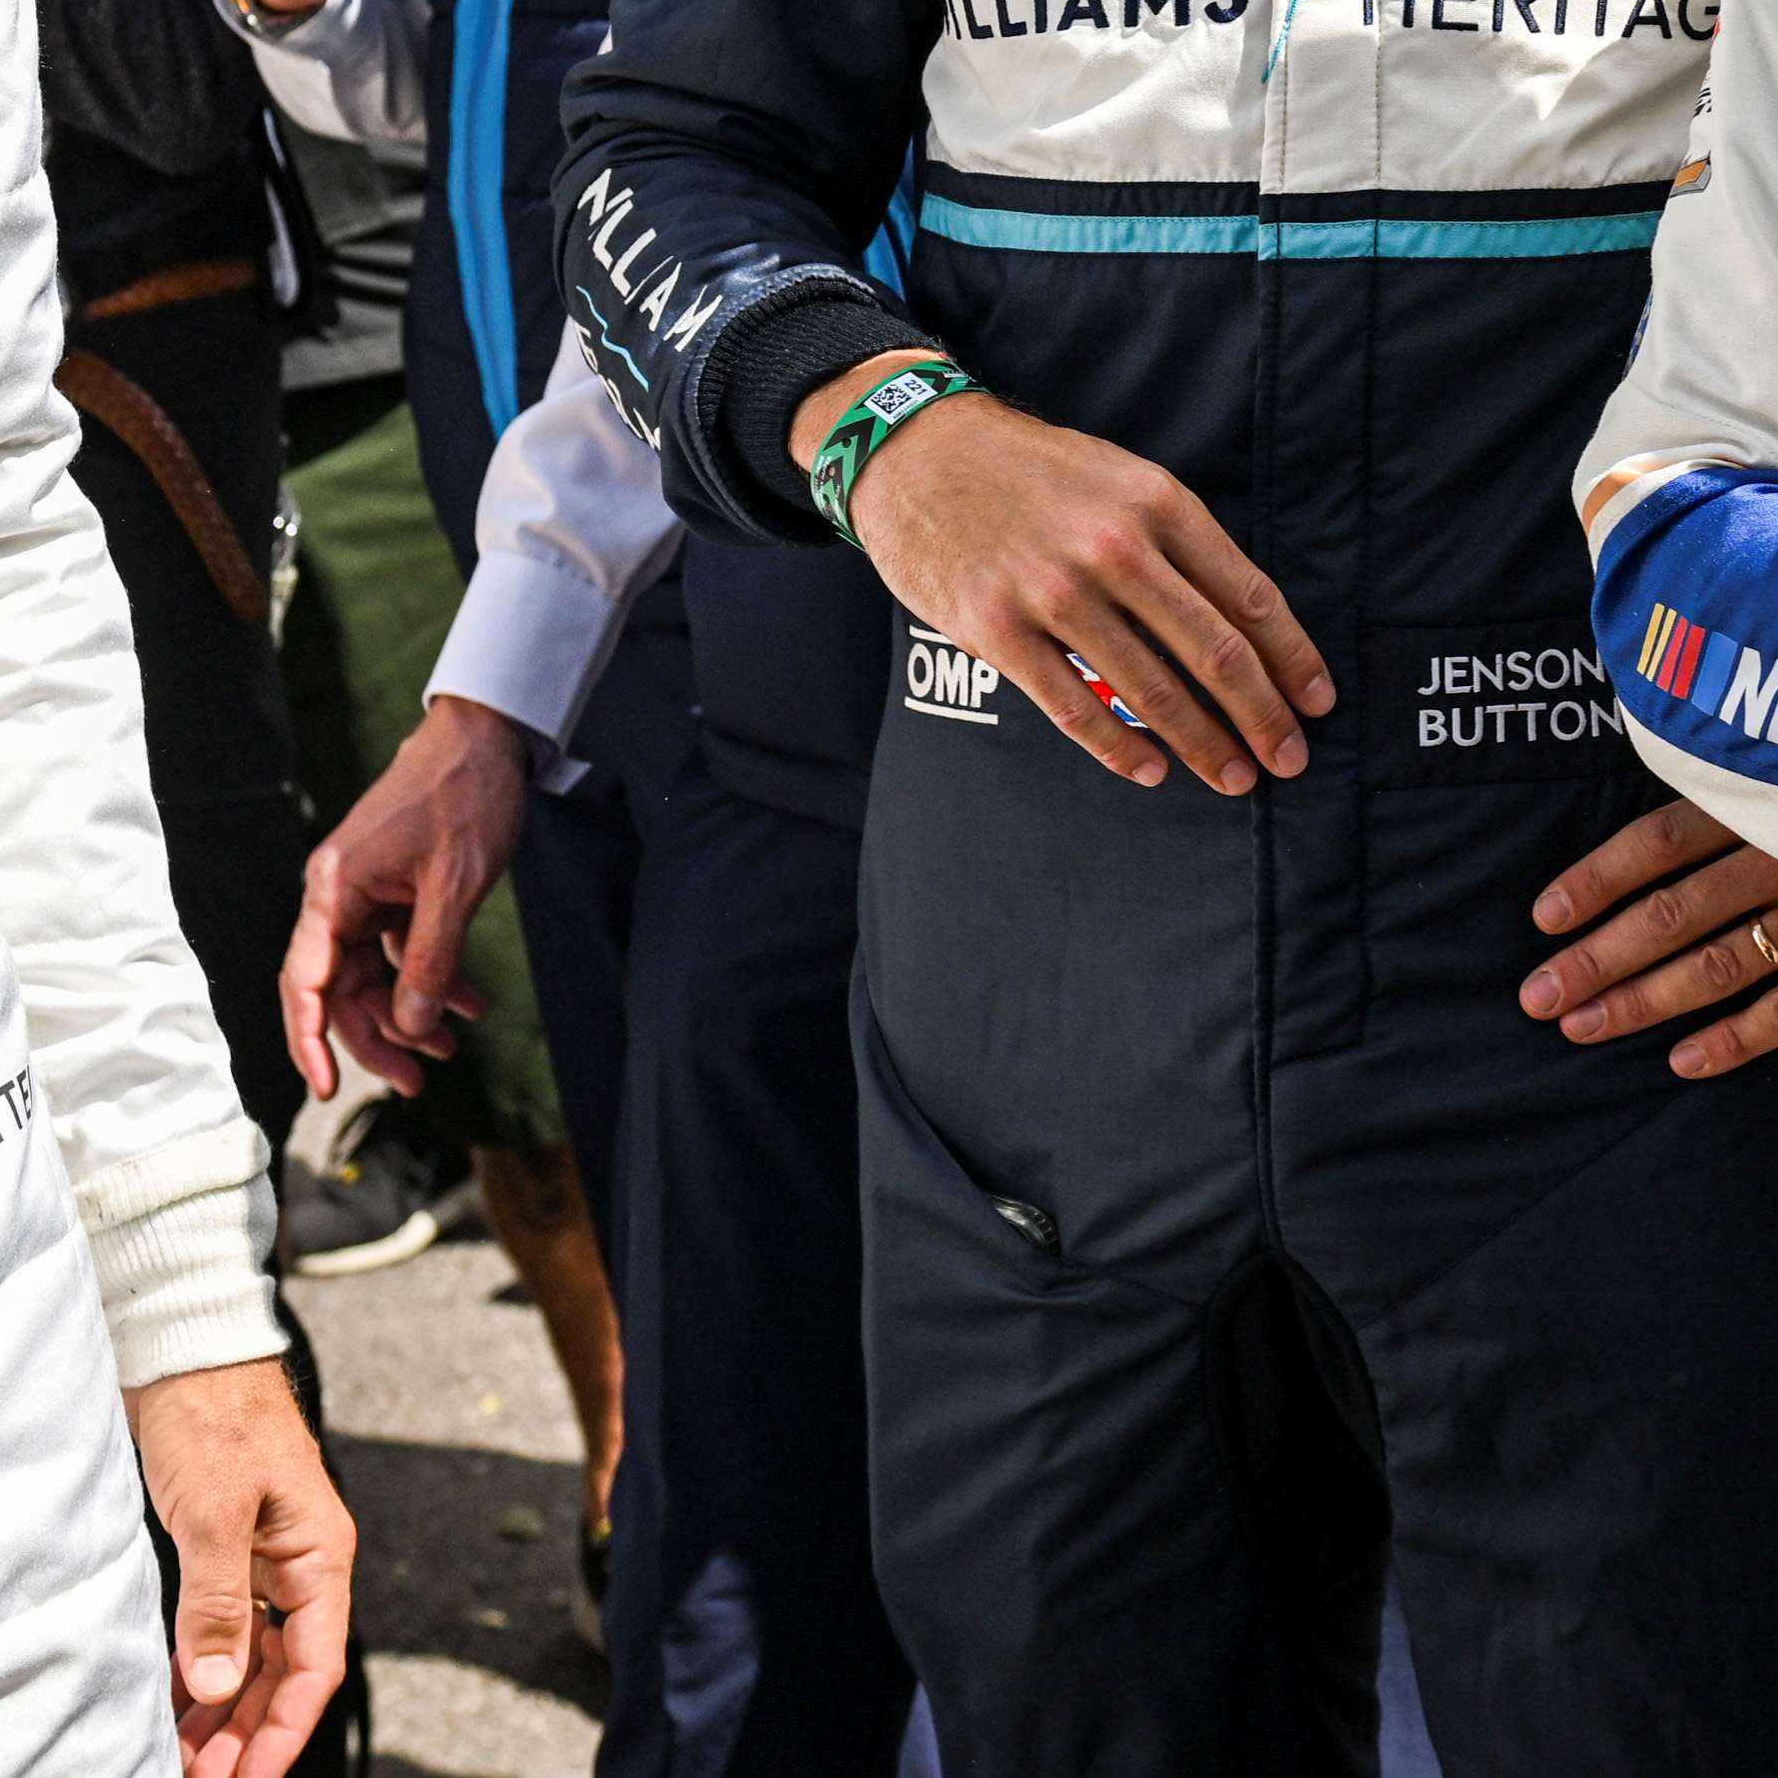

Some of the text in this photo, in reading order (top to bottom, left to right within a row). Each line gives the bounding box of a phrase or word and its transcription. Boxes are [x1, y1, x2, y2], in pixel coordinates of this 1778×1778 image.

[907, 642, 1000, 708] OMP
[1416, 647, 1605, 696] JENSON
[1418, 697, 1624, 748] BUTTON
